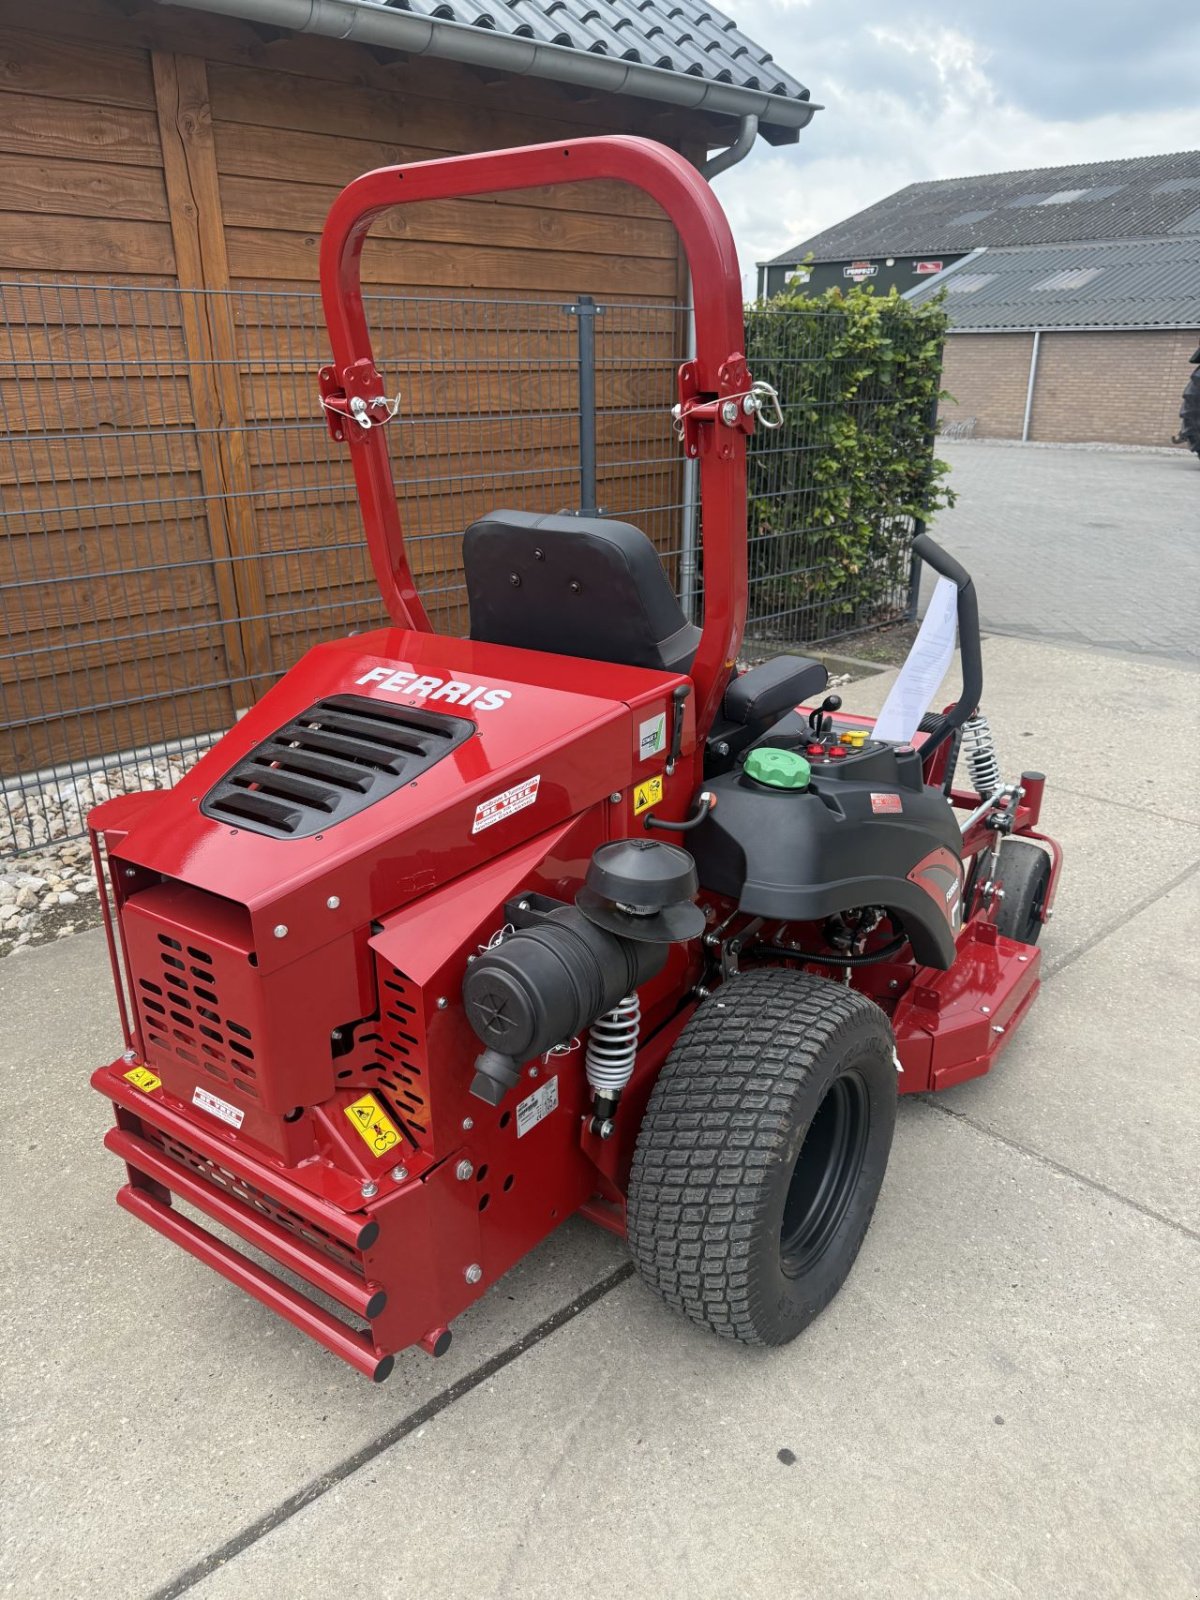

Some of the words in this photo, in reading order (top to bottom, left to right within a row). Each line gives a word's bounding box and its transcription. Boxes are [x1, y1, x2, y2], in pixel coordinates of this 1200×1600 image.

[355, 666, 512, 711] FERRIS
[482, 806, 498, 818] DE
[502, 788, 531, 805] VREE
